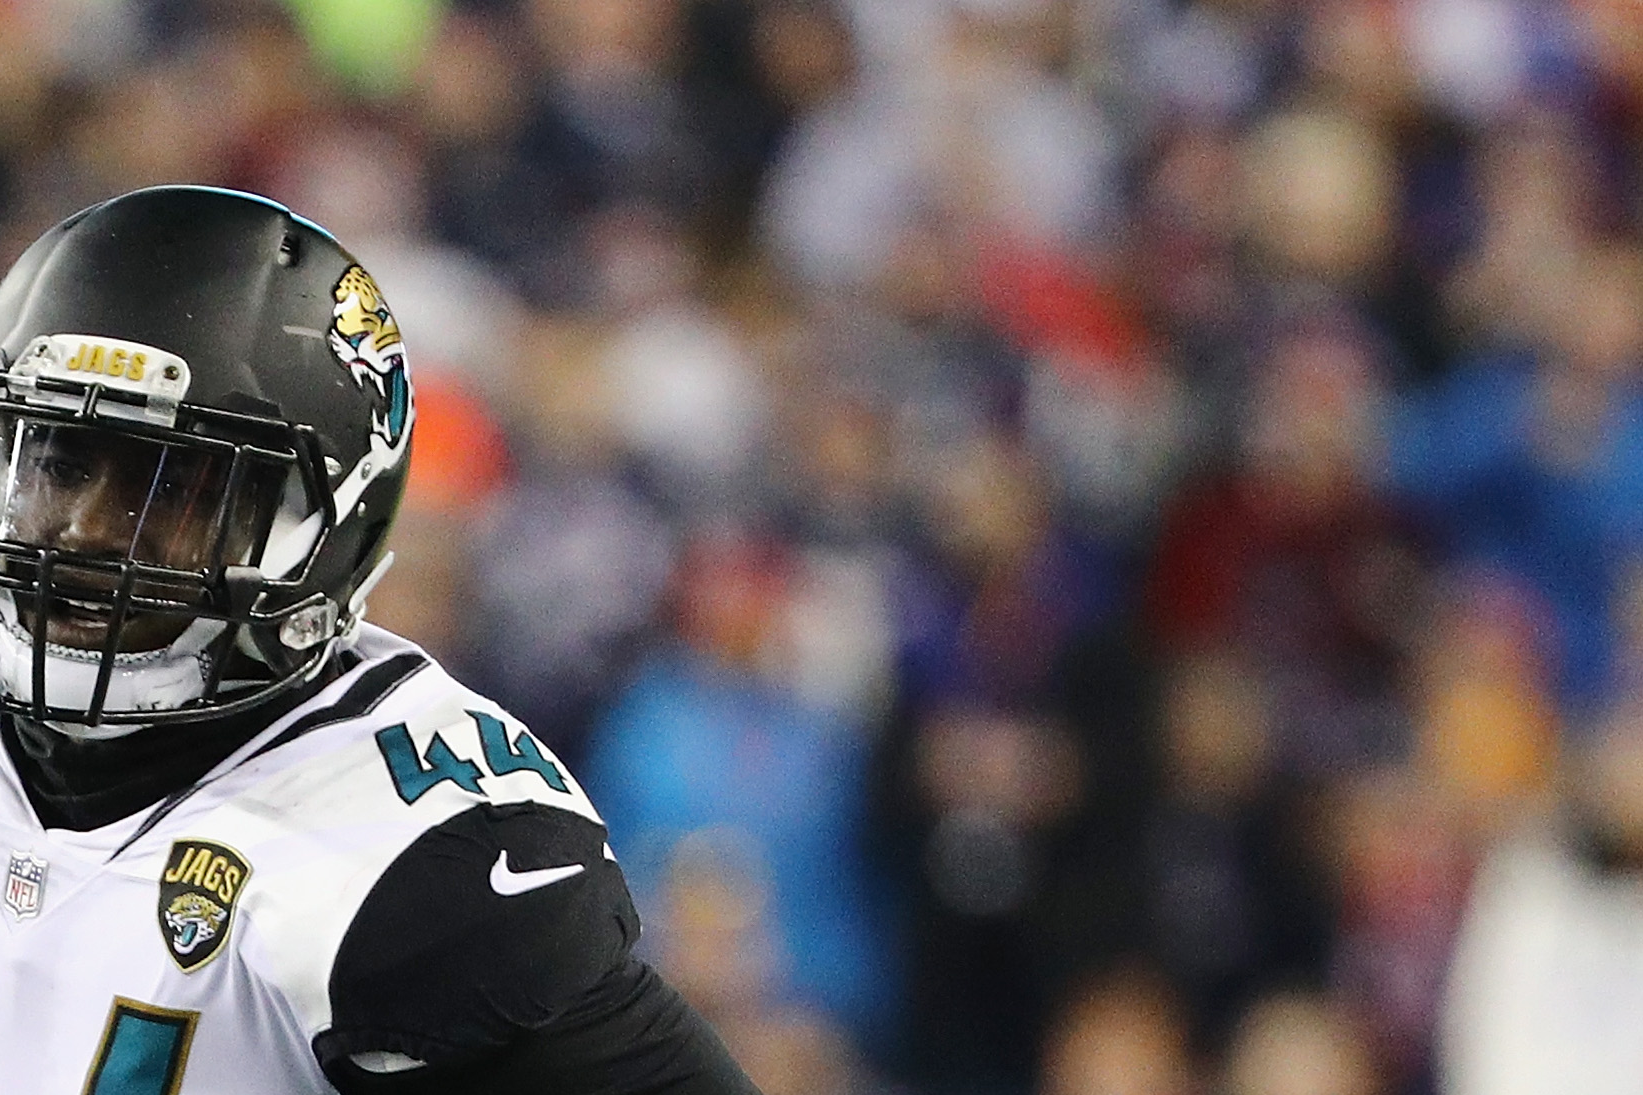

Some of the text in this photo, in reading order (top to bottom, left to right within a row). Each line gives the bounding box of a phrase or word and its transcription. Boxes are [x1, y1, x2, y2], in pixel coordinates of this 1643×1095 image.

[66, 343, 147, 381] JAGS
[374, 708, 572, 806] 44
[9, 878, 35, 908] NFL
[165, 847, 241, 904] JAGS
